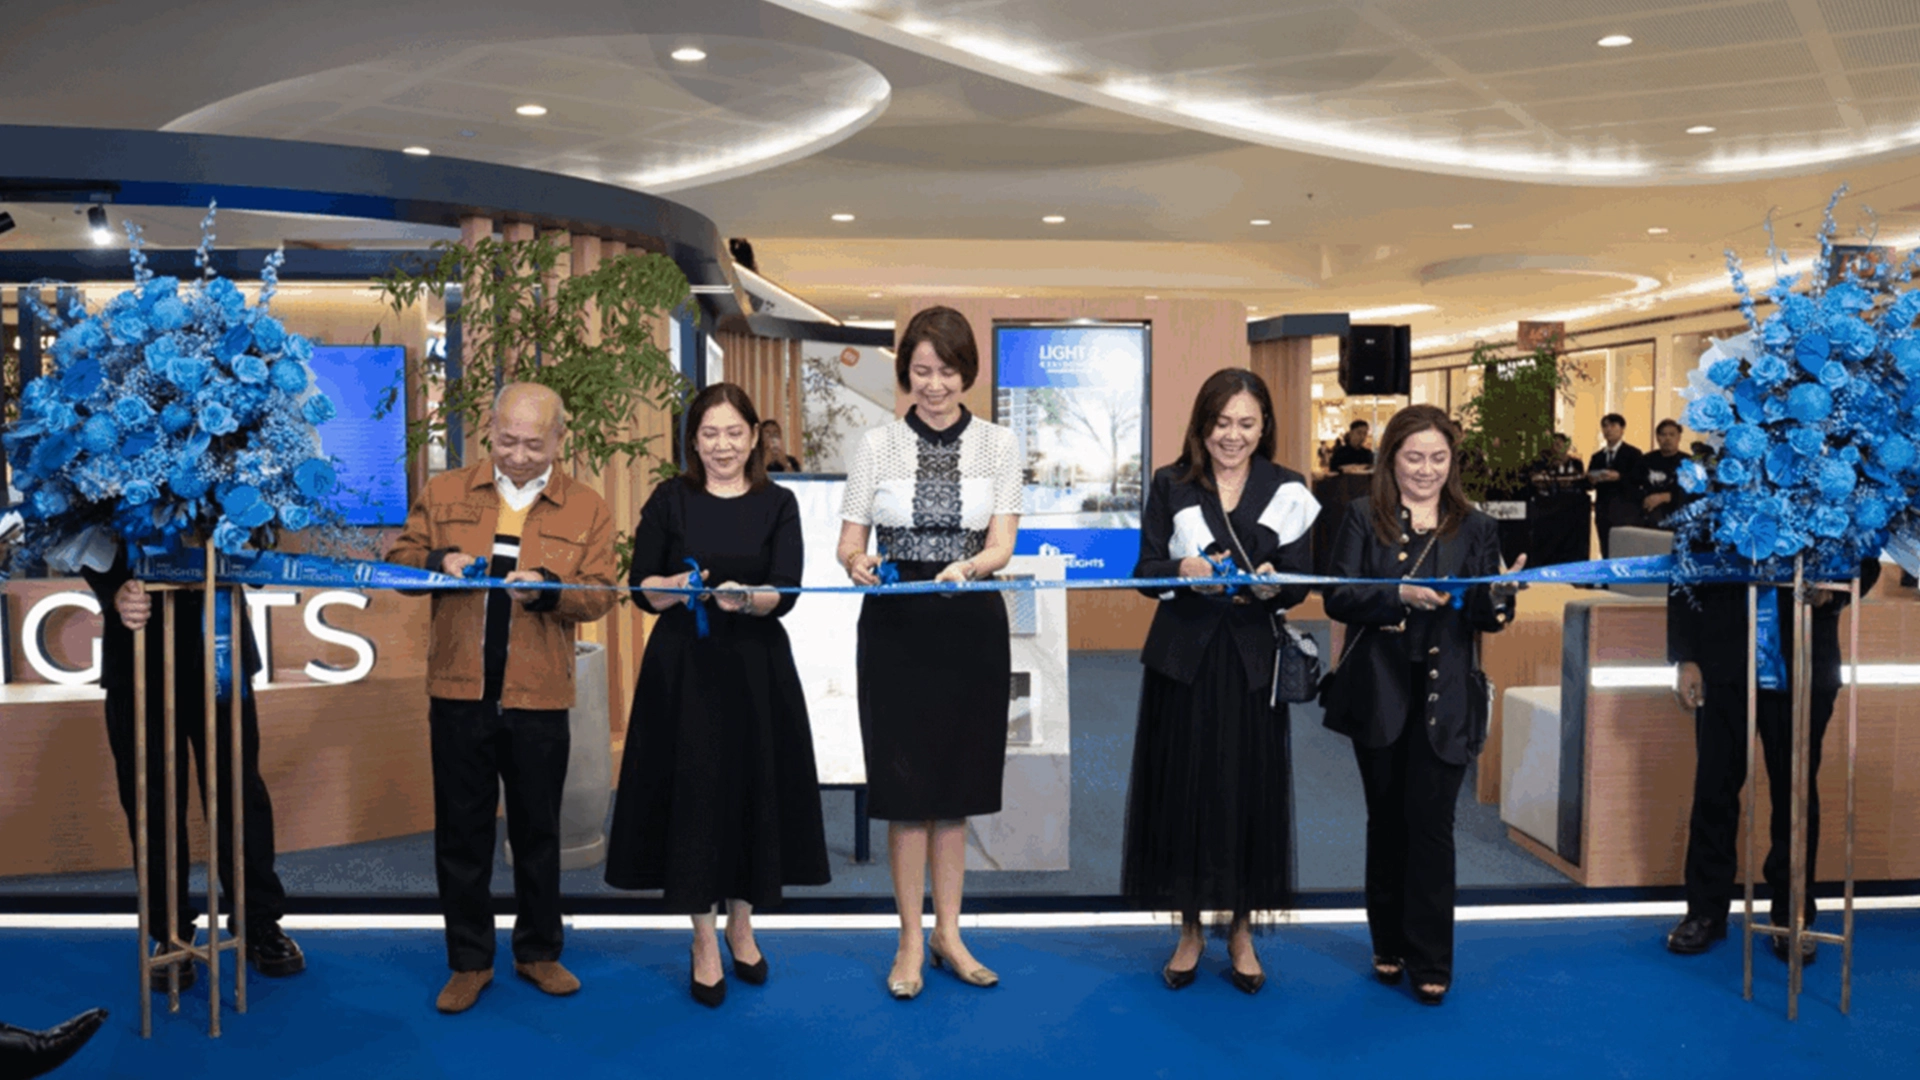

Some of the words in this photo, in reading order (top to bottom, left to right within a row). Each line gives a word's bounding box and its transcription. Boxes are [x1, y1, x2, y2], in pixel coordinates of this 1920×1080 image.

[1039, 345, 1086, 360] LIGHT
[155, 566, 204, 578] HEIGHTS
[229, 567, 273, 579] HEIGHTS
[302, 573, 345, 582] HEIGHTS
